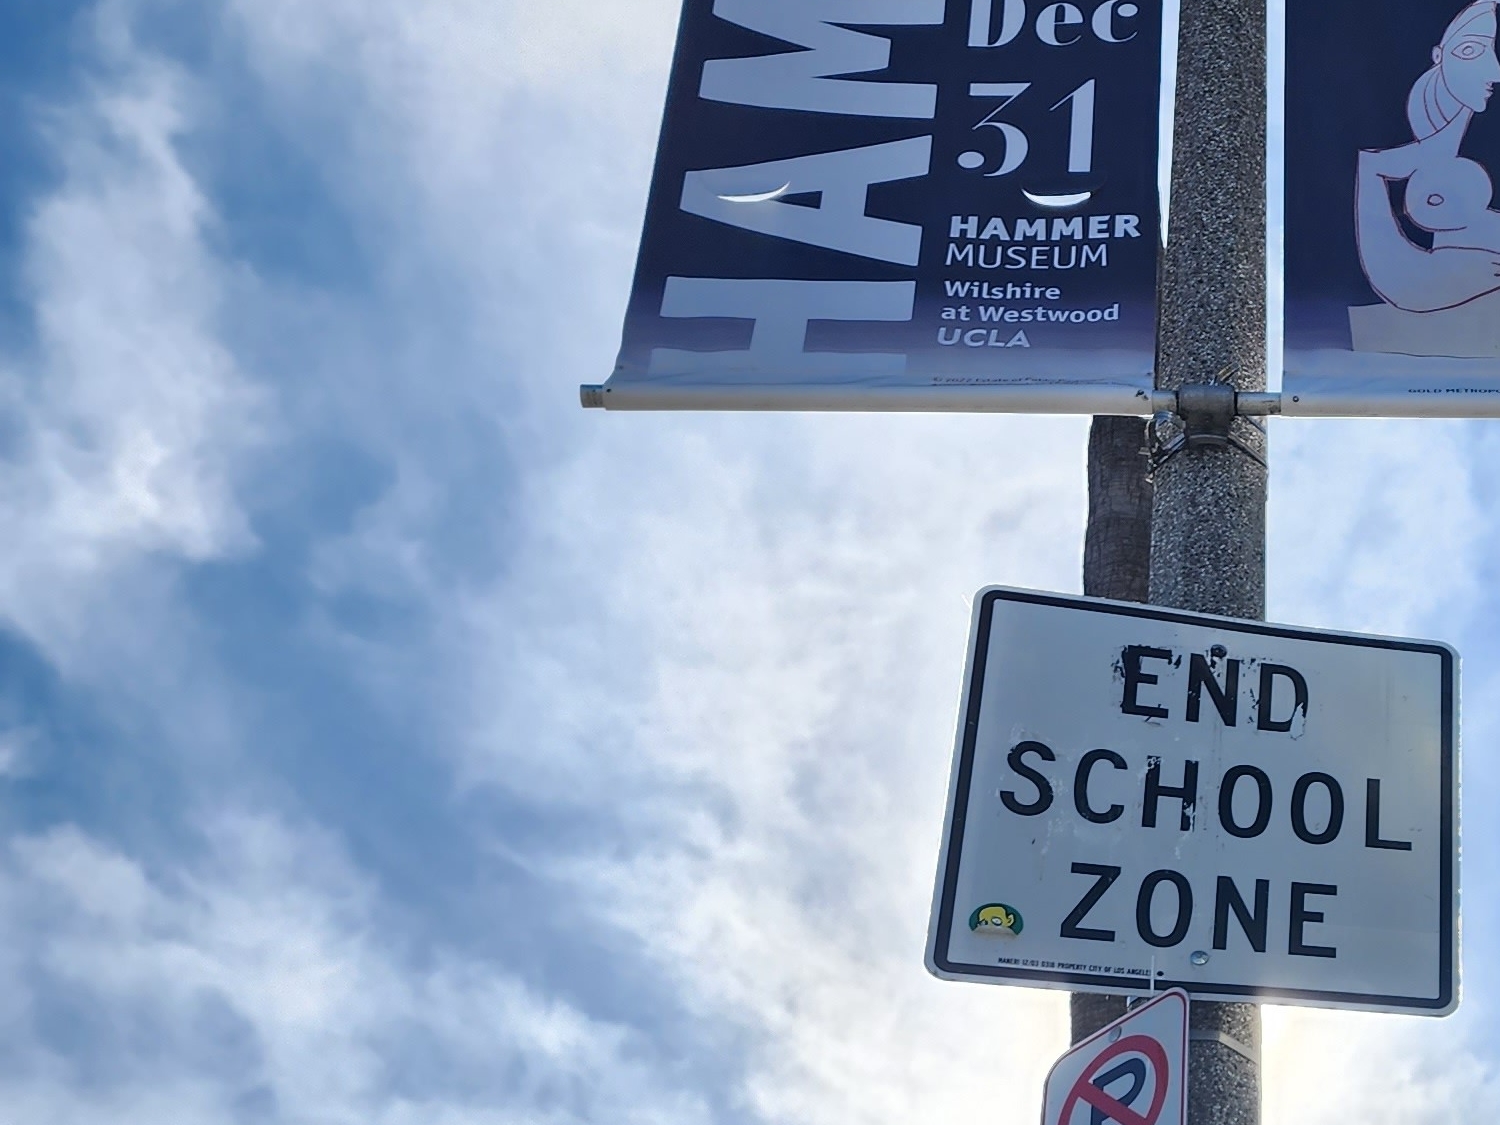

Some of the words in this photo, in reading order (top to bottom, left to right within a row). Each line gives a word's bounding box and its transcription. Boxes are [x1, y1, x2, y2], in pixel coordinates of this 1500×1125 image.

[957, 78, 1096, 177] 31
[949, 214, 1142, 242] HAMMER
[945, 243, 1108, 269] MUSEUM
[943, 280, 1061, 300] Wilshire
[941, 305, 971, 321] at
[977, 303, 1120, 323] Westwood
[936, 326, 1031, 348] UCLA
[1120, 645, 1310, 733] END
[999, 741, 1412, 852] SCHOOL
[1059, 862, 1339, 959] ZONE
[1088, 964, 1102, 973] CITY
[1104, 966, 1112, 974] OF
